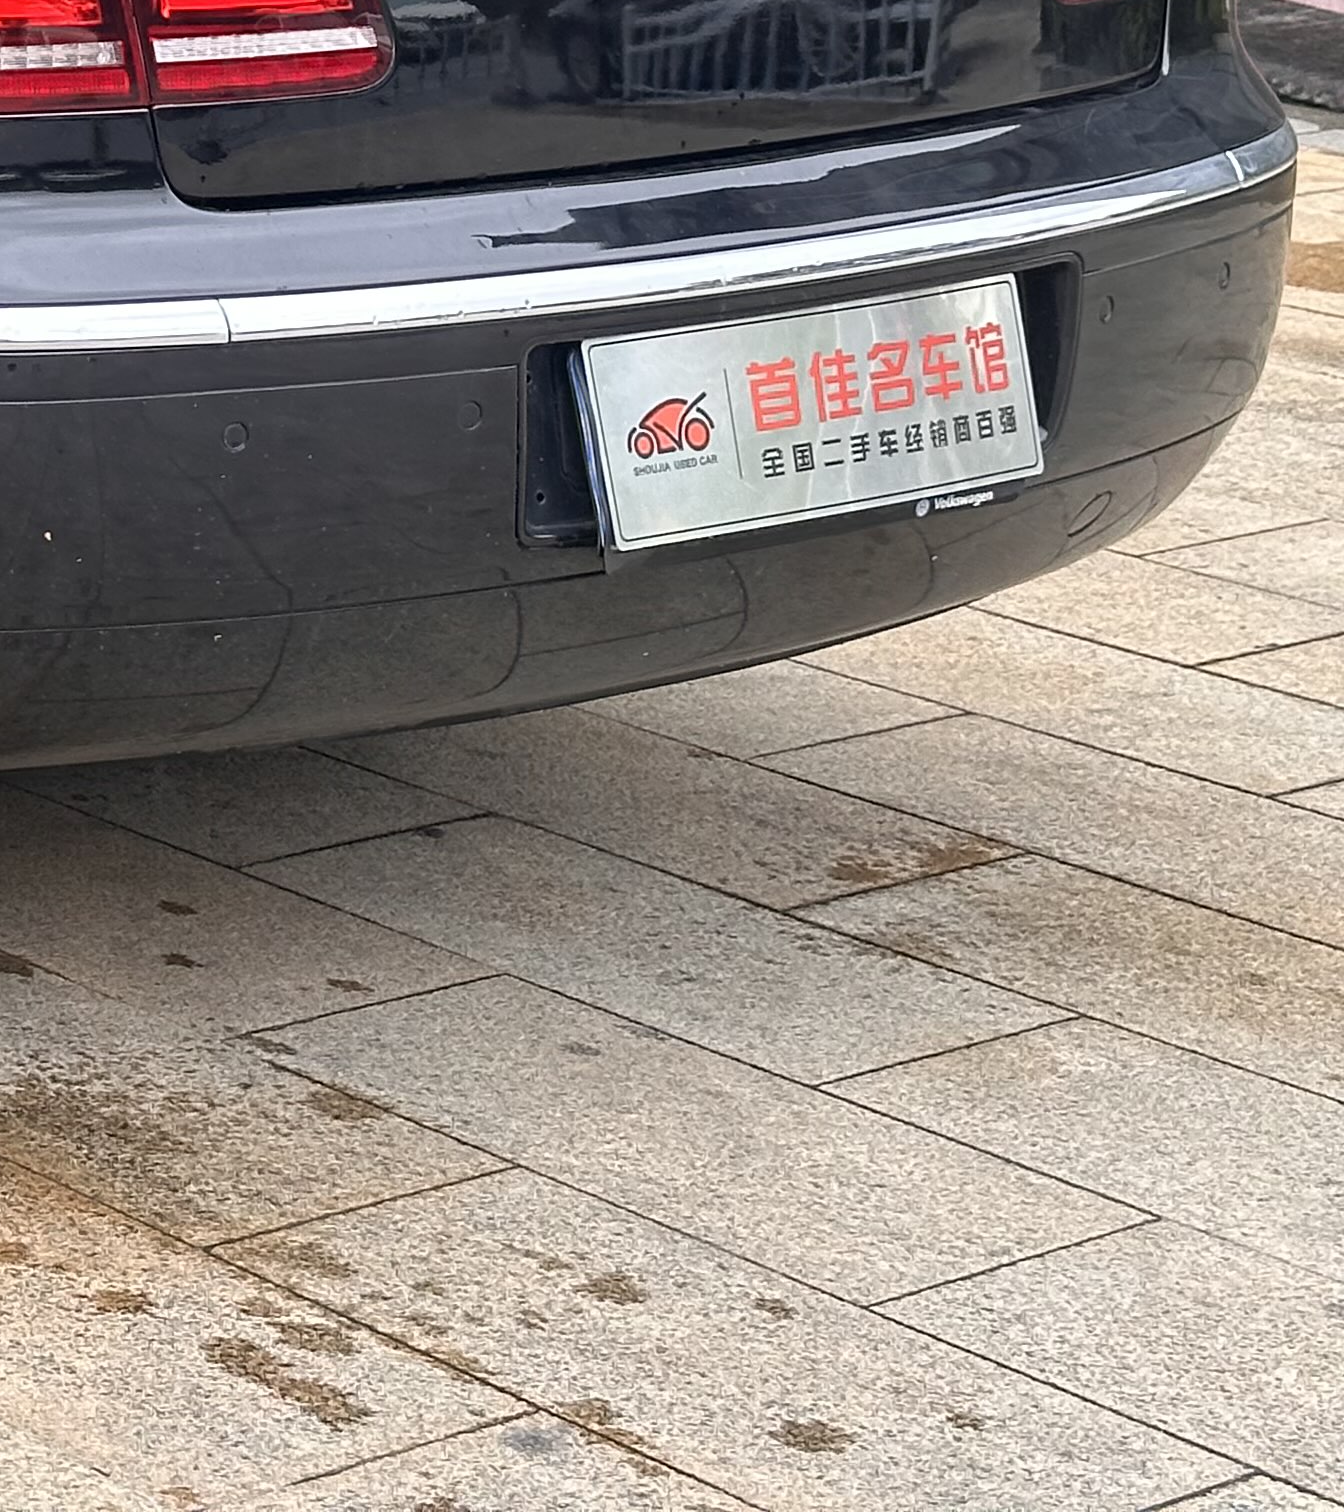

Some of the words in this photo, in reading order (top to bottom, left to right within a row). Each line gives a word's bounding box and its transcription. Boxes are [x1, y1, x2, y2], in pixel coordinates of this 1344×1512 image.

[745, 322, 1011, 432] 首佳名车馆
[674, 457, 697, 470] USED
[699, 453, 719, 466] CAR
[761, 405, 1018, 479] 全国二手车经销商百强
[934, 490, 994, 510] Volkswagen
